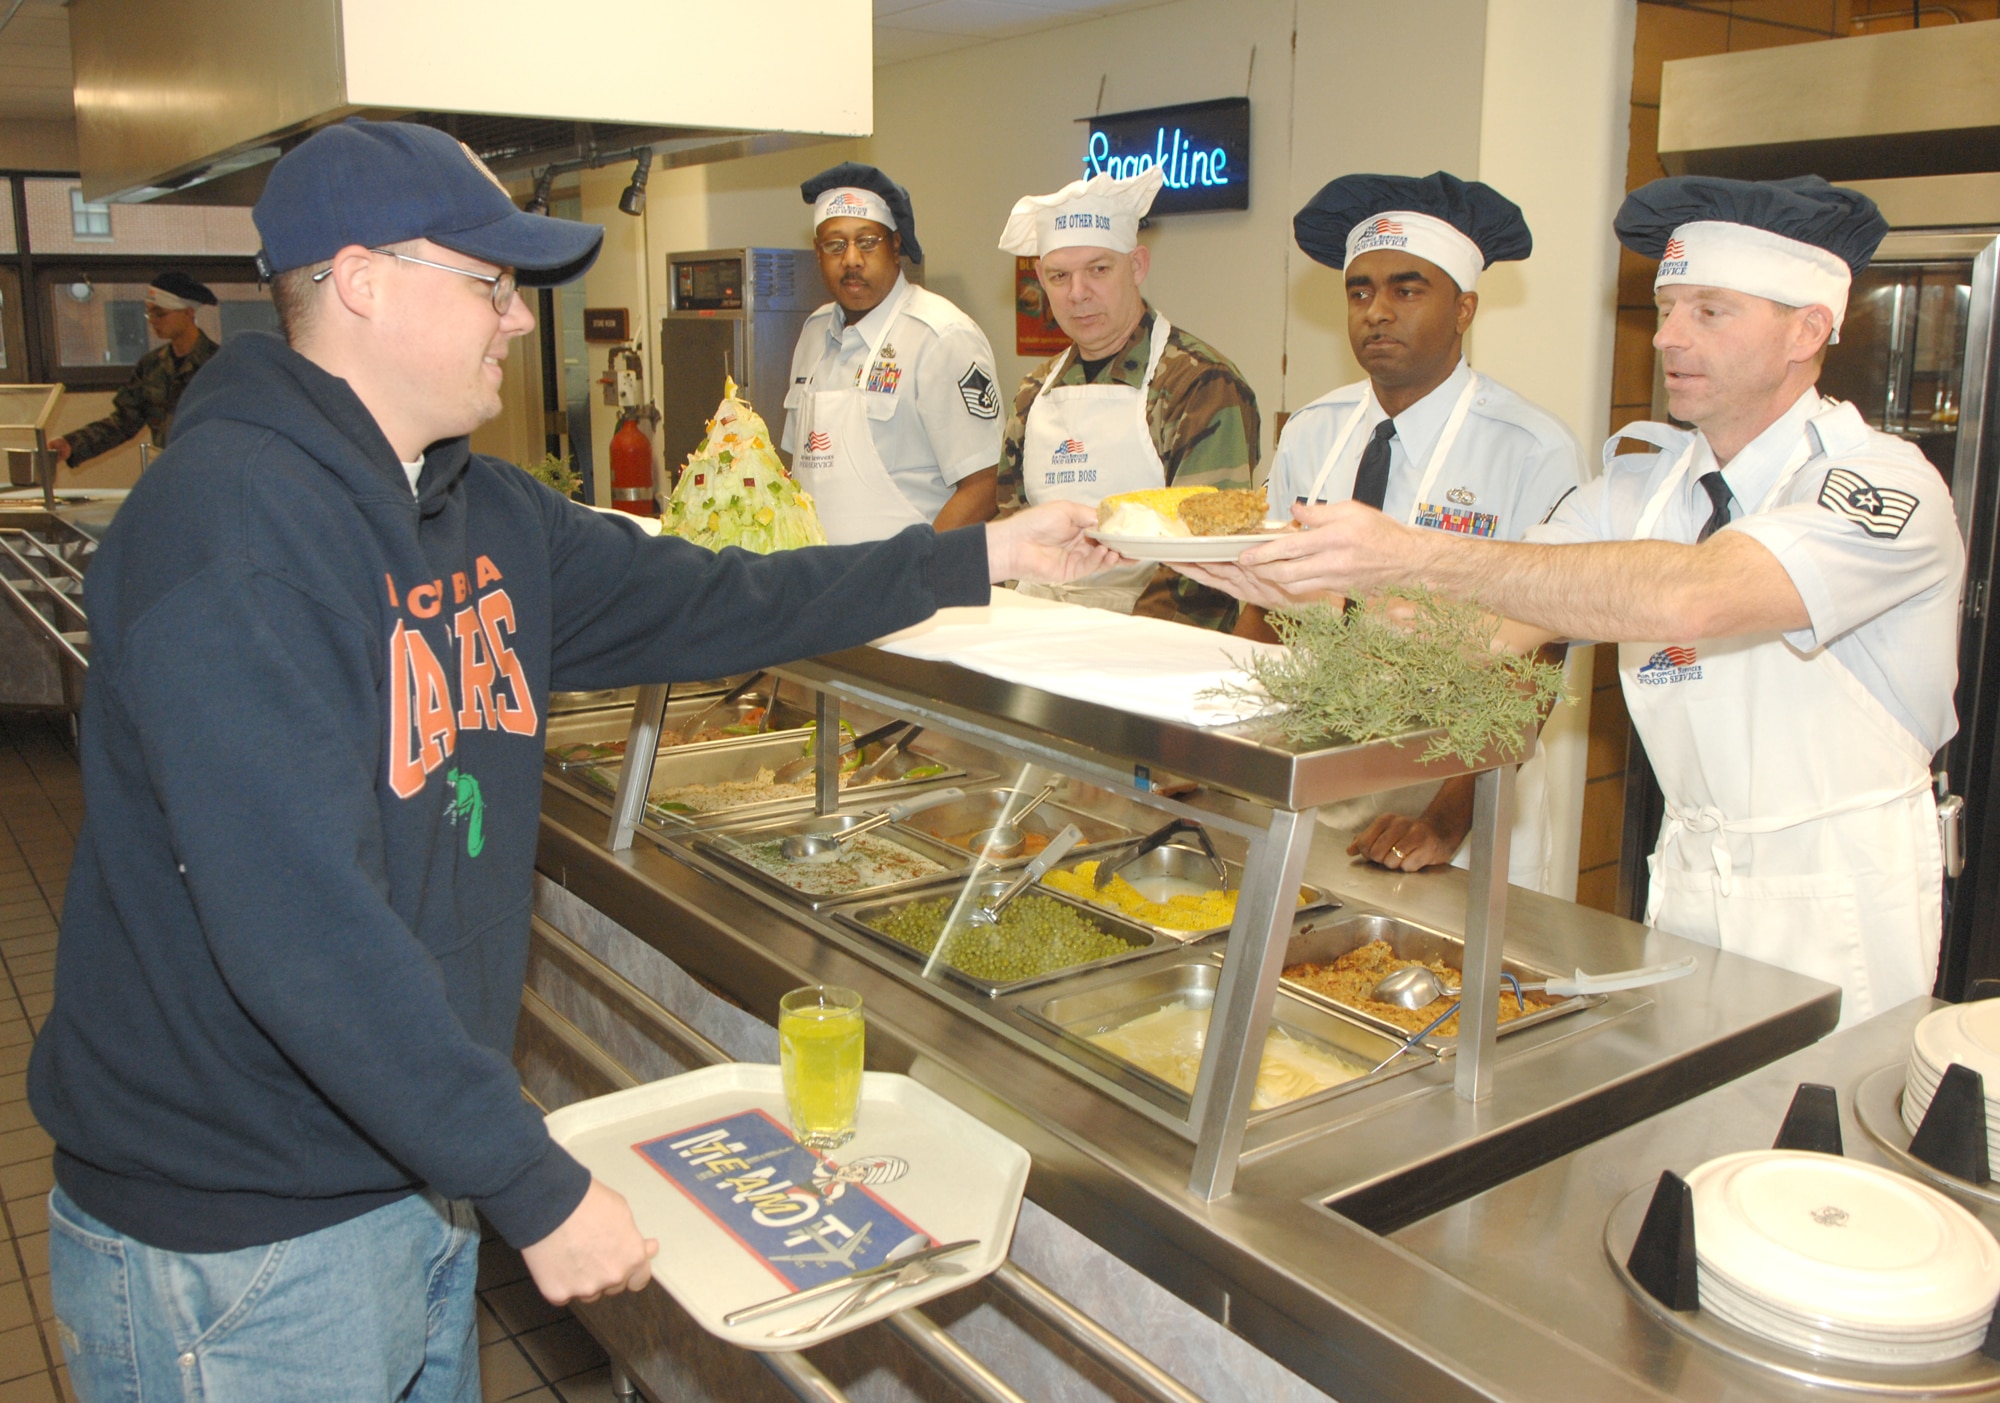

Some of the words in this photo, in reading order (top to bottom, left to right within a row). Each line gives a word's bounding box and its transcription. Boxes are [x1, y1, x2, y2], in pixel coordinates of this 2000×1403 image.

[1055, 215, 1067, 230] THE
[1069, 213, 1093, 228] OTHER
[1095, 214, 1111, 231] BOSS
[1369, 239, 1407, 248] SERVICE
[1045, 472, 1056, 484] THE
[1057, 470, 1075, 484] OTHER
[1078, 469, 1097, 482] BOSS
[1639, 677, 1668, 686] FOOD
[1669, 671, 1703, 684] SERVICE
